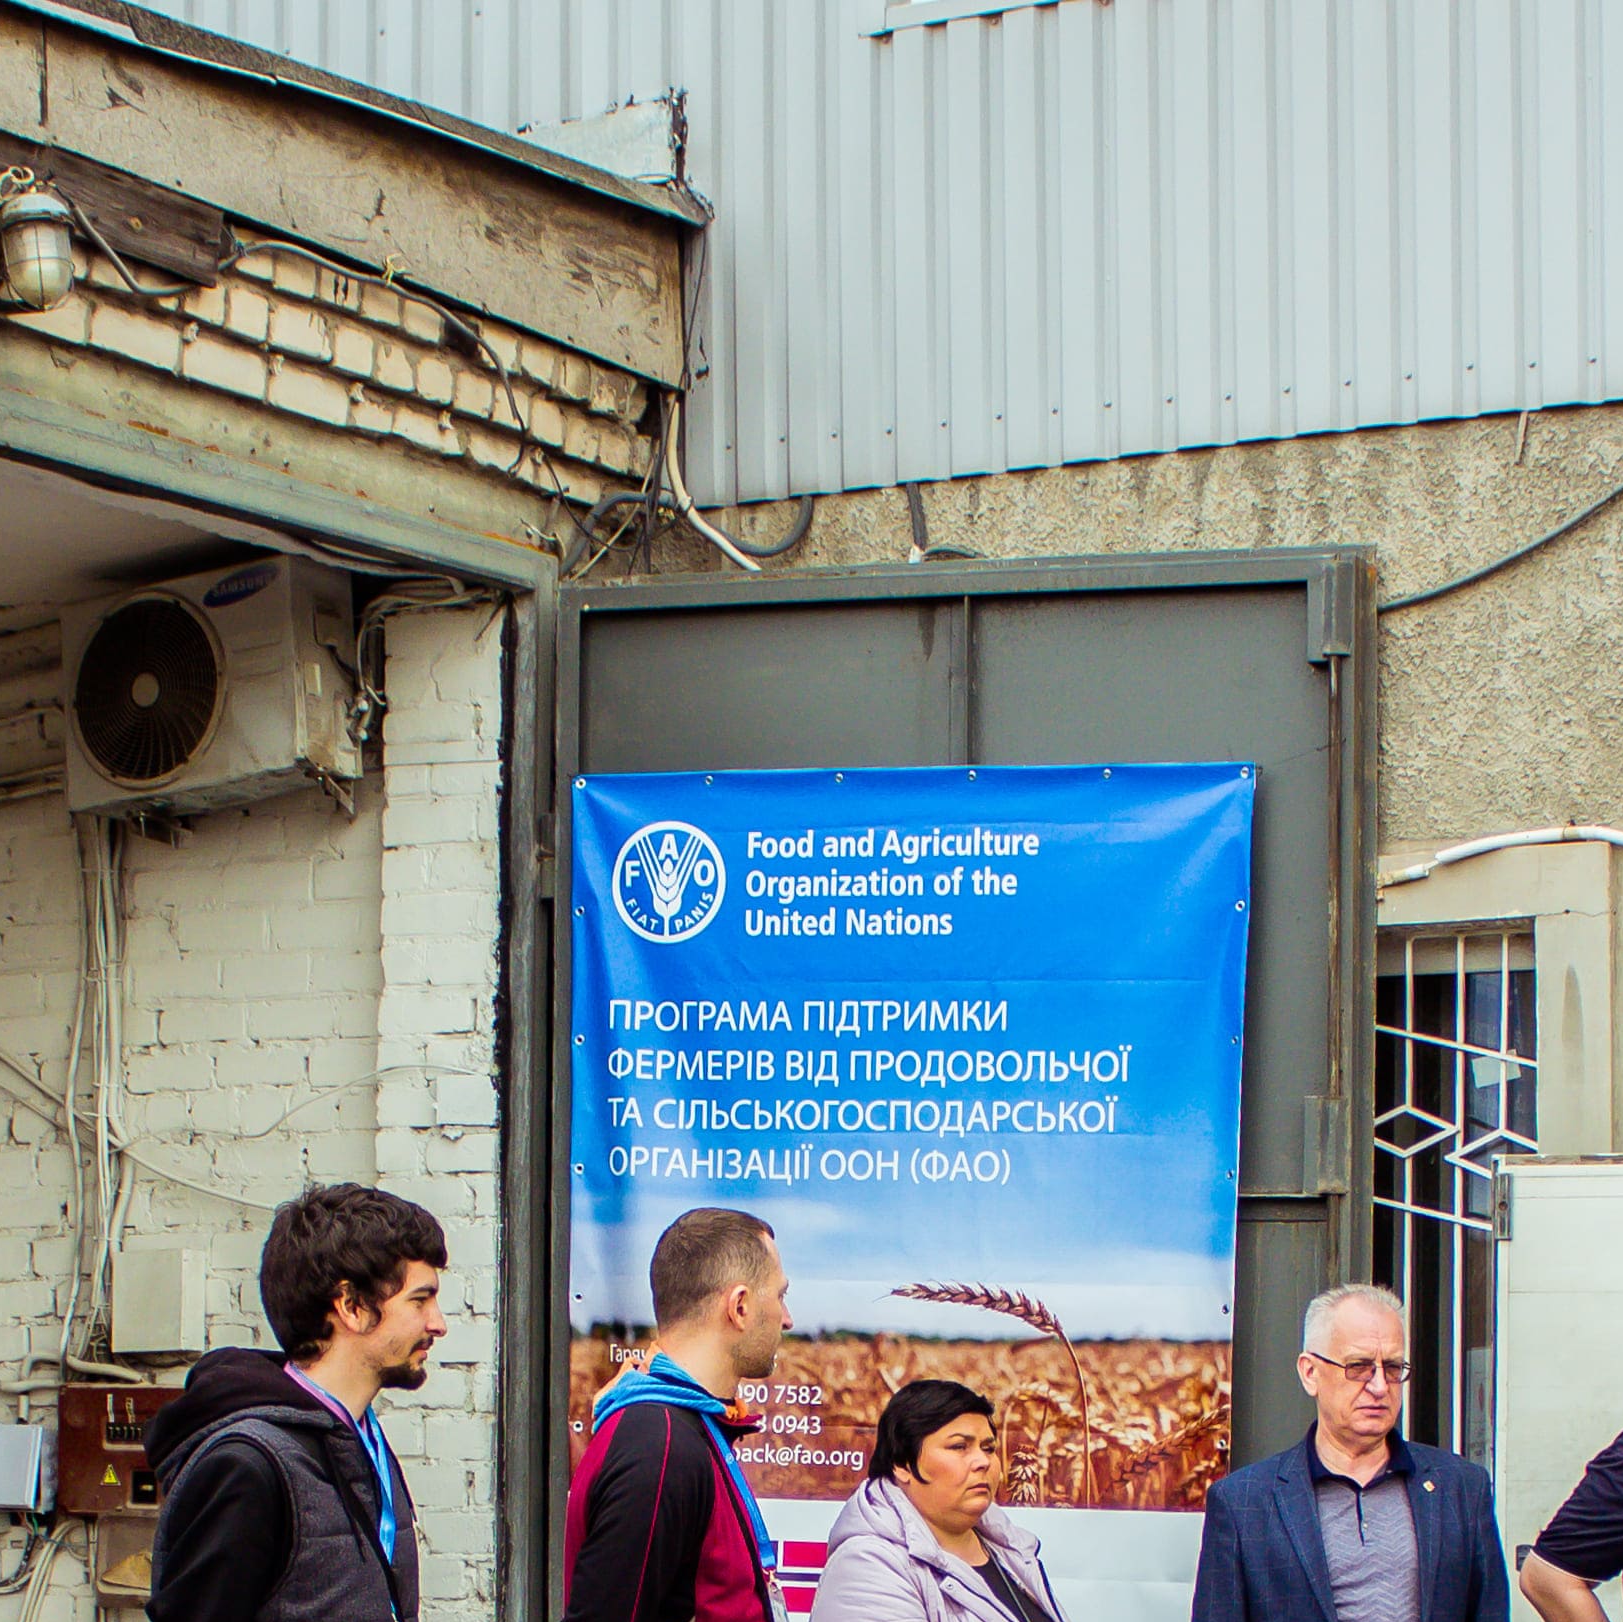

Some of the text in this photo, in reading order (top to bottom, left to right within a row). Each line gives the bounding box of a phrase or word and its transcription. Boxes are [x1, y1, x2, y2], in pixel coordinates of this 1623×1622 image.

[747, 826, 1040, 864] Food and Agriculture
[745, 861, 1018, 904] Organization of the
[625, 891, 715, 932] FIAT PANIS
[745, 906, 953, 936] United Nations
[609, 999, 1007, 1038] ПРОГРАМА ПІДТРИМКИ
[608, 1044, 1132, 1088] ФЕРМЕРІВ ВІД ПРОДОВОЛЬЧОЇ
[608, 1095, 1119, 1139] ТА СІЛЬСЬКОГОСПОДАРСЬКОЇ
[609, 1143, 1011, 1186] ОРГАНІЗАЦІЇ ООН (ФАО)
[774, 1385, 823, 1405] 7582
[772, 1415, 822, 1435] 0943
